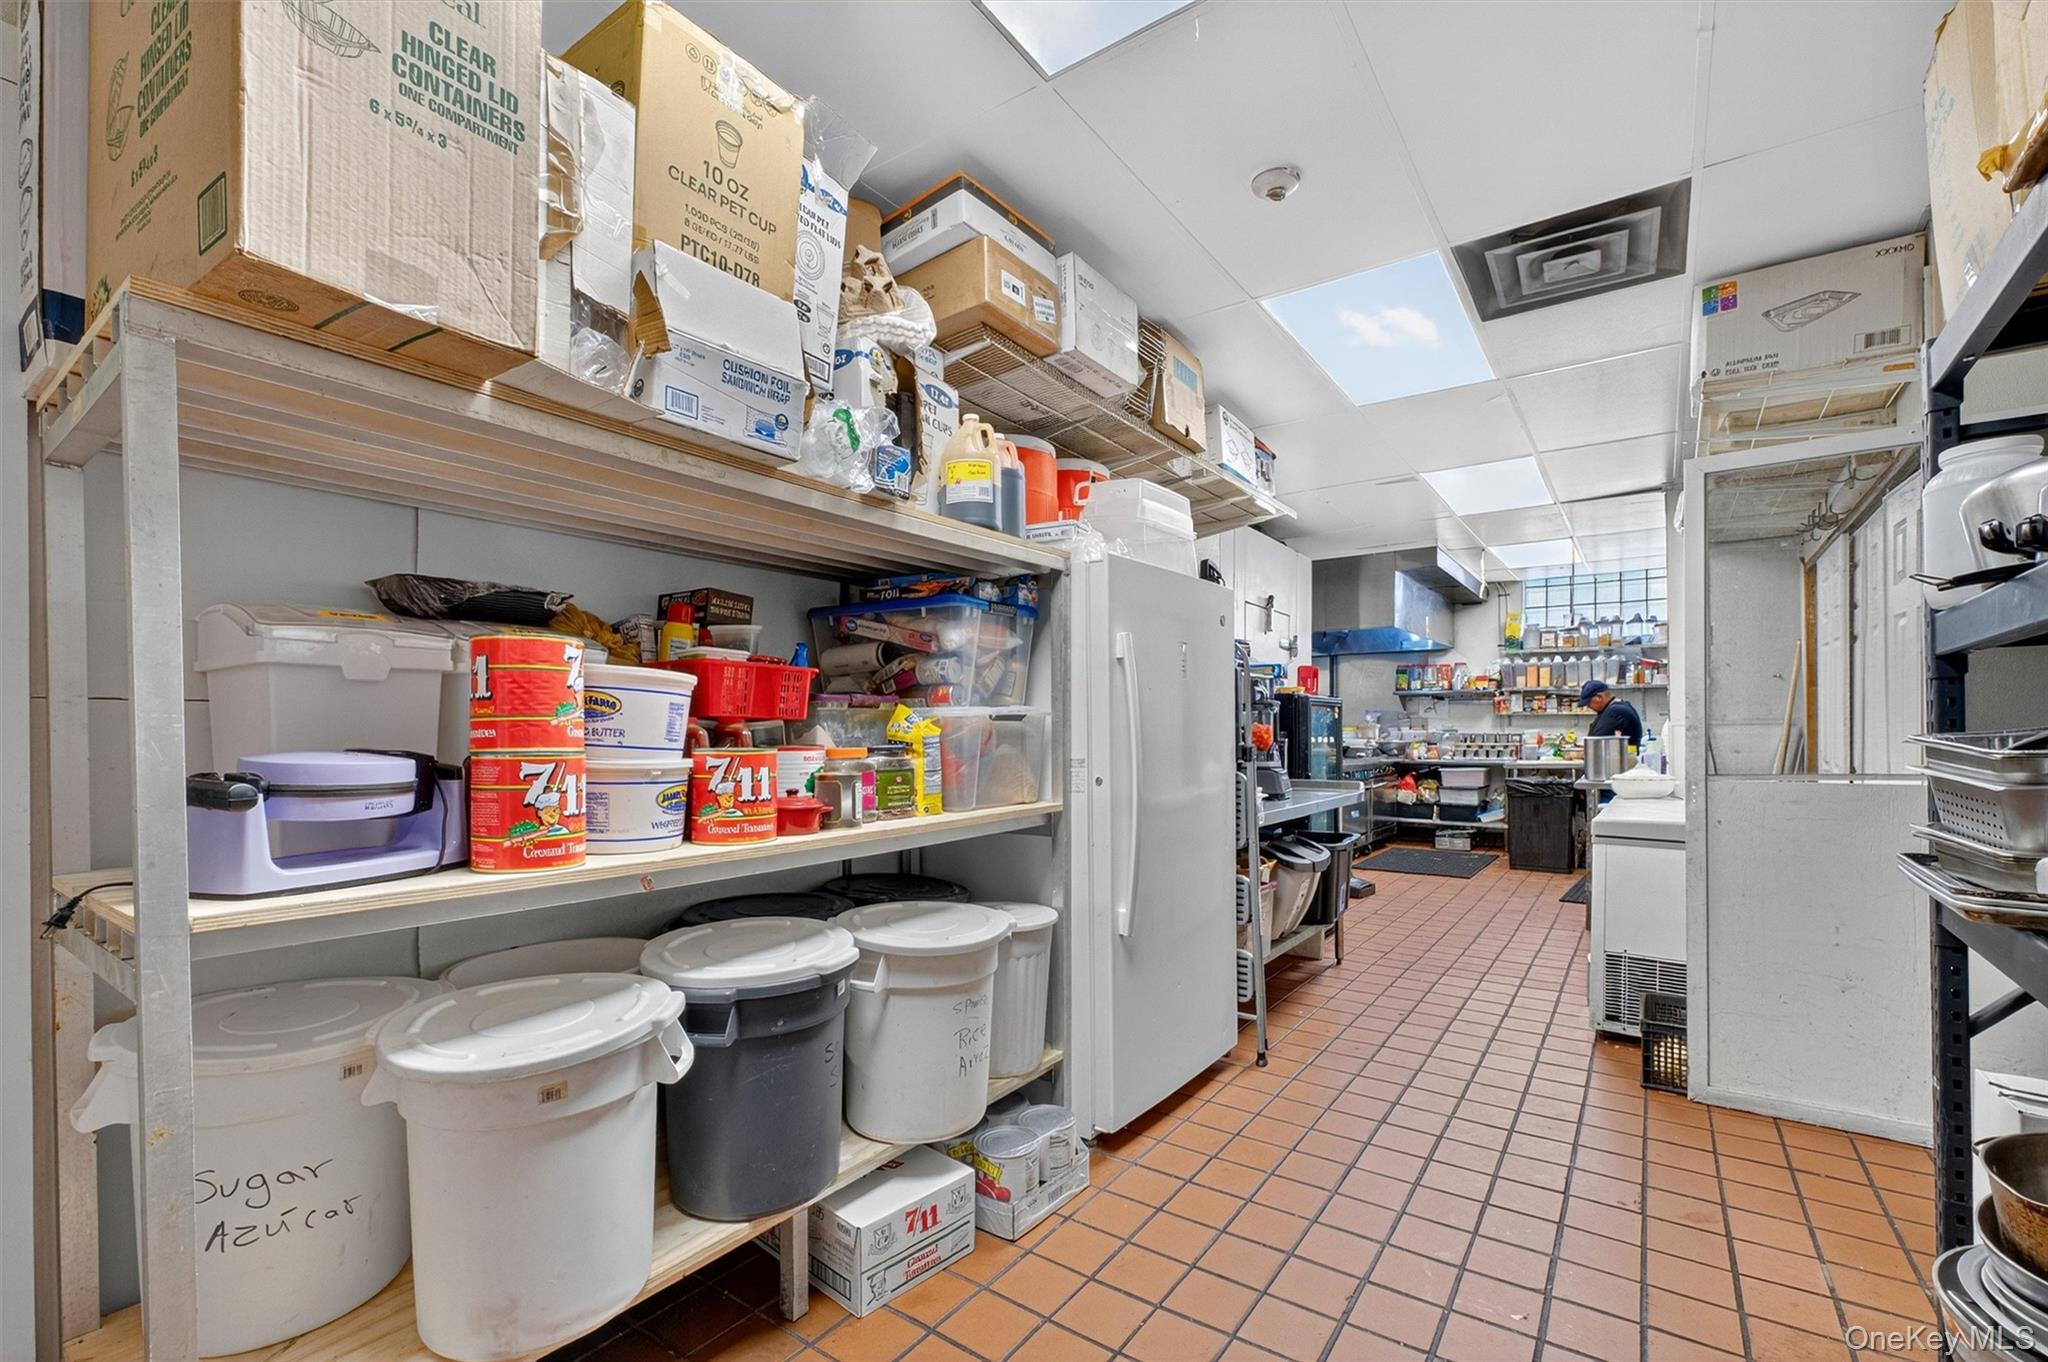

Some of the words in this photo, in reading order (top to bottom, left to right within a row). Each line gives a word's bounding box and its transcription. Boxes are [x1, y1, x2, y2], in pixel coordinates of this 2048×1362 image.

[137, 30, 192, 118] CONTAINERS
[141, 22, 172, 82] HINGED
[401, 30, 481, 93] HINGED
[489, 80, 519, 115] LID
[429, 21, 496, 78] CLEAR
[392, 52, 526, 142] CONTAINERS
[399, 82, 425, 107] ONE
[428, 98, 519, 156] COMPARTMENT
[369, 98, 380, 115] 6
[437, 133, 448, 149] 3
[668, 165, 718, 203] CLEAR
[719, 194, 747, 219] PET
[748, 211, 777, 235] CUP
[703, 160, 723, 186] 10
[727, 178, 750, 202] OZ
[721, 371, 766, 397] SANDWICH
[767, 388, 791, 405] WRAP
[722, 359, 769, 385] CUSHION
[770, 376, 791, 393] FOIL
[591, 727, 625, 738] BUTTER
[705, 756, 773, 803] 7/11
[195, 1158, 334, 1209] Sugar
[904, 1202, 940, 1238] 7/11
